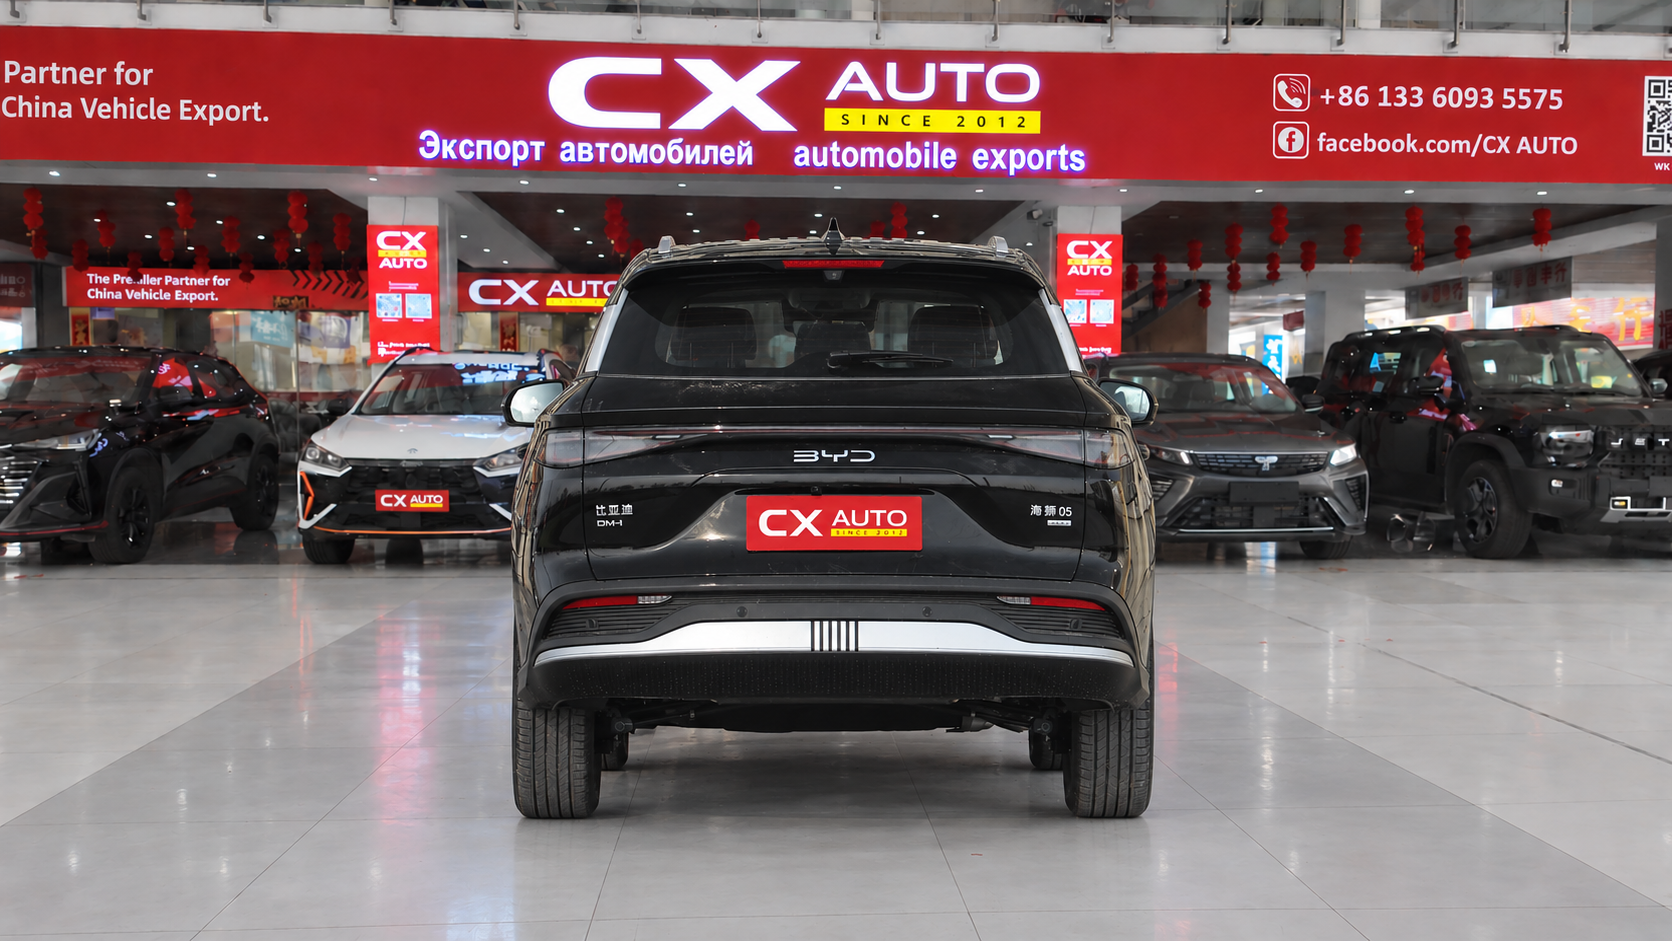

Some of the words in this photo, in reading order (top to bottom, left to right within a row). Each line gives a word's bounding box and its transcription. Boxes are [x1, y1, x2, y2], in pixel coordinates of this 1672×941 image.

[4, 60, 107, 85] Partner
[113, 60, 154, 86] for
[548, 56, 801, 132] CX
[826, 61, 1040, 103] AUTO
[1320, 85, 1369, 107] +86
[1378, 85, 1424, 108] 133
[1432, 87, 1494, 109] 6093
[1502, 87, 1563, 110] 5575
[1, 94, 73, 119] China
[79, 96, 171, 121] Vehicle
[179, 99, 269, 127] Export.
[841, 113, 931, 127] SINCE
[956, 115, 1026, 128] 2012
[418, 129, 545, 167] Экспорт
[558, 137, 754, 166] автомобилей
[1316, 132, 1511, 158] facebook.com/CX
[1516, 136, 1578, 155] AUTO
[793, 140, 957, 170] automobile
[971, 143, 1086, 176] exports
[376, 230, 427, 251] CX
[1066, 240, 1113, 260] CX
[379, 257, 428, 269] AUTO
[1067, 265, 1113, 276] AUTO
[86, 273, 110, 285] The
[164, 274, 210, 286] Partner
[212, 275, 231, 287] for
[86, 288, 123, 300] China
[124, 288, 172, 301] Vehicle
[174, 289, 219, 303] Export.
[468, 278, 539, 306] CX
[793, 449, 876, 463] BYD
[380, 494, 407, 508] CX
[410, 494, 443, 504] AUTO
[595, 503, 634, 517] 比亚迪
[758, 509, 823, 537] CX
[831, 509, 908, 527] AUTO
